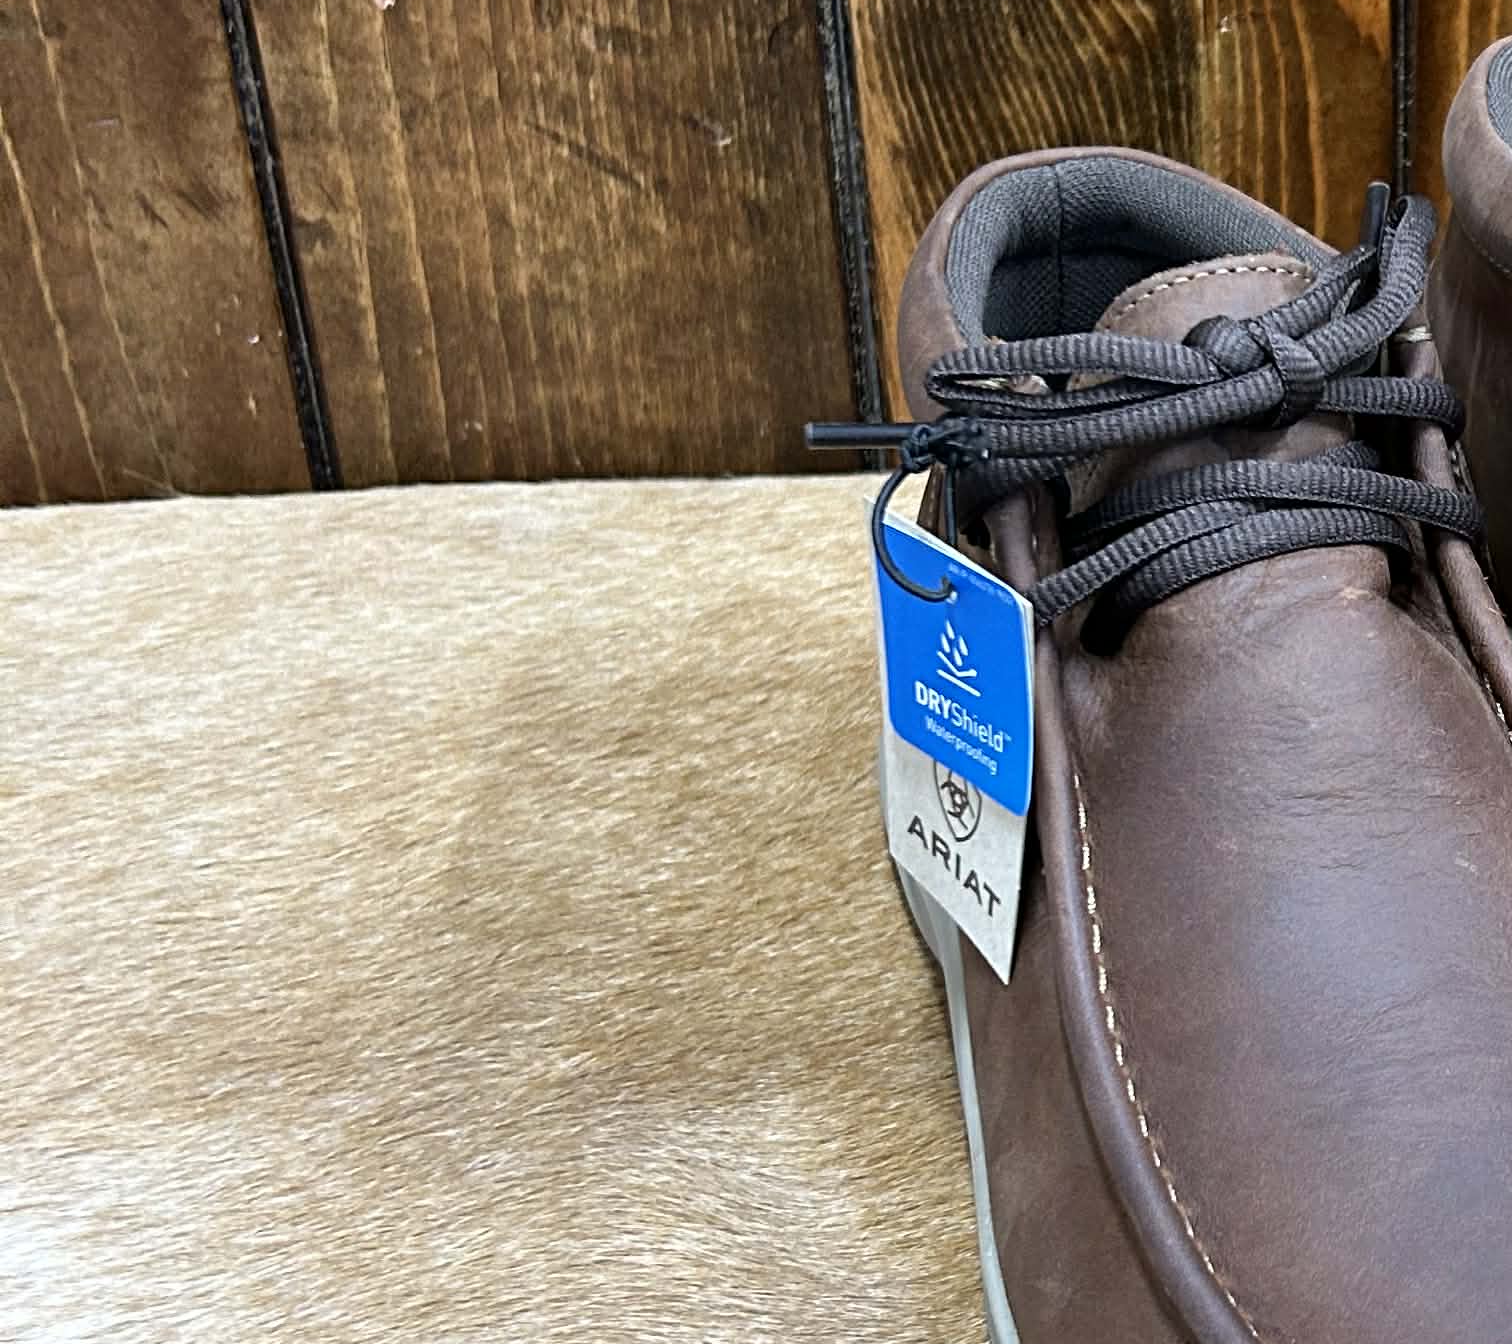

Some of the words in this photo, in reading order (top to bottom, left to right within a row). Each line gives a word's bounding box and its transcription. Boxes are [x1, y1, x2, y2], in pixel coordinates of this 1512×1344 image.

[914, 680, 1005, 753] DRYShield
[925, 715, 998, 776] Waterproofing
[907, 815, 1001, 917] ARIAT
